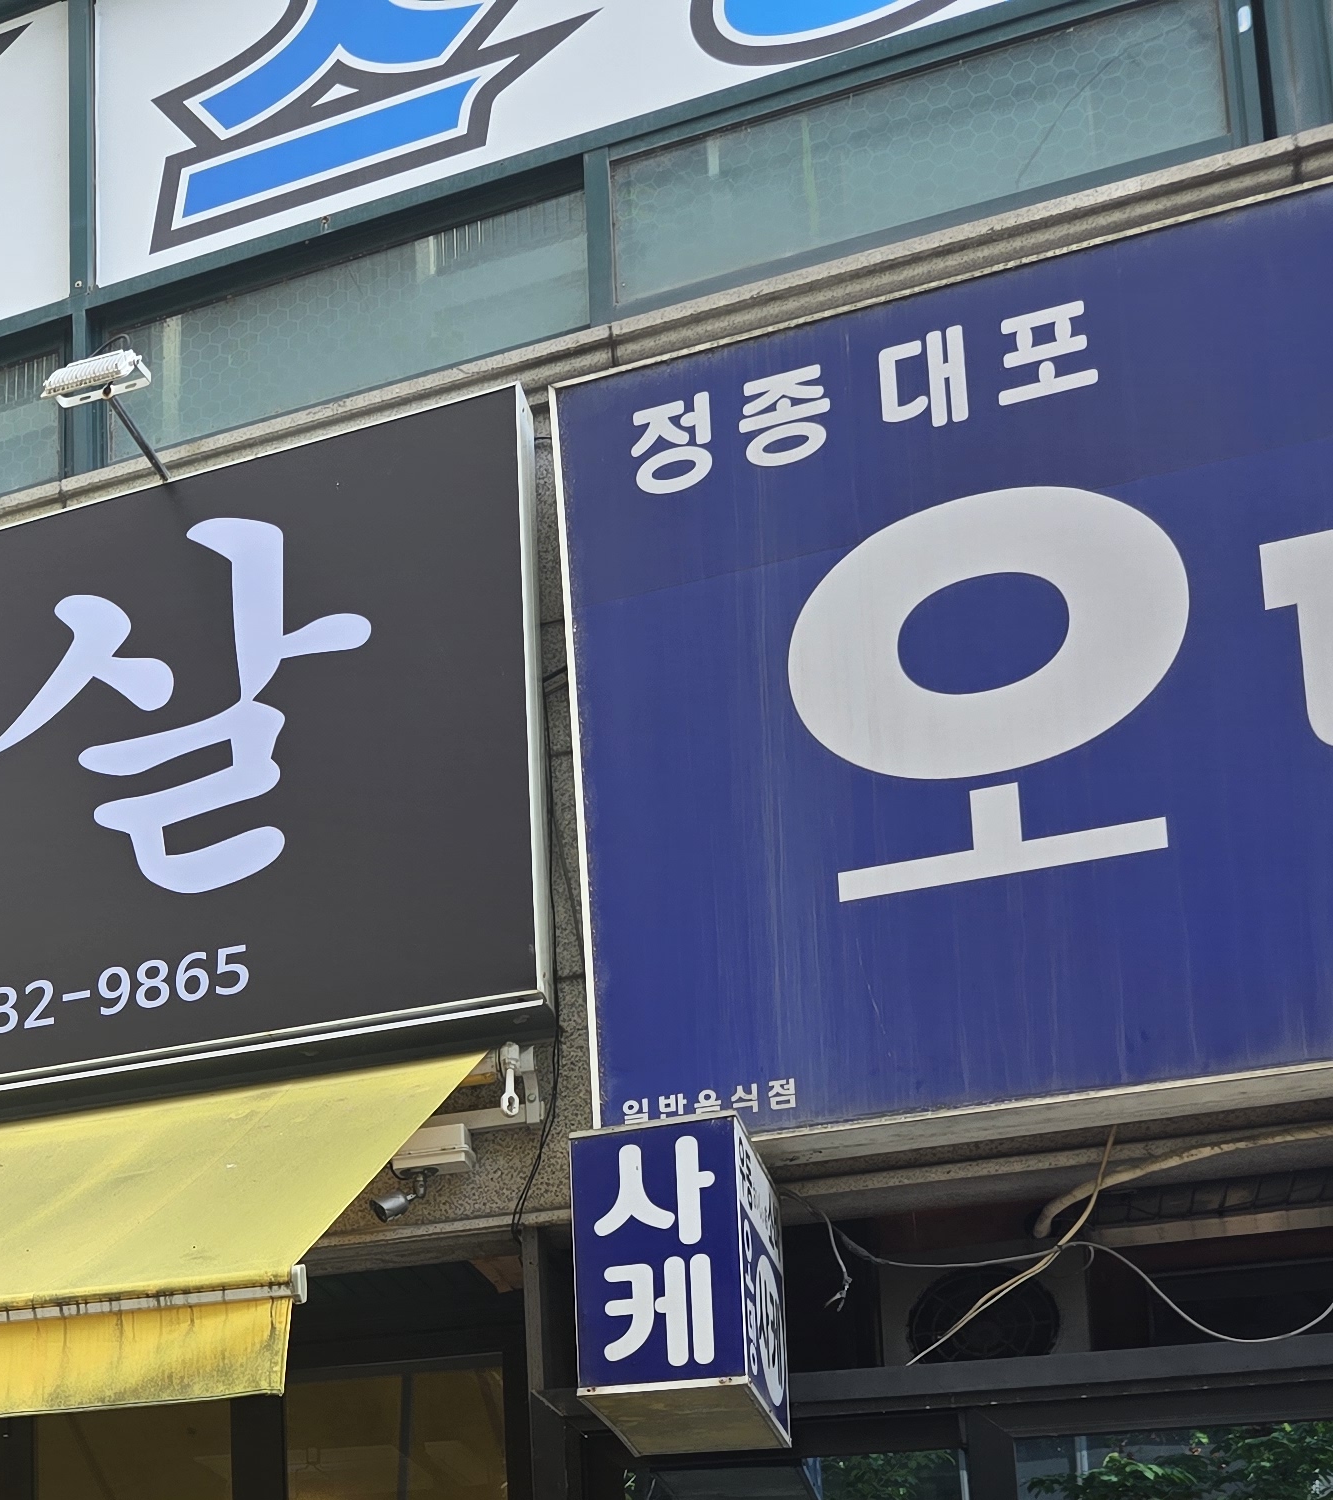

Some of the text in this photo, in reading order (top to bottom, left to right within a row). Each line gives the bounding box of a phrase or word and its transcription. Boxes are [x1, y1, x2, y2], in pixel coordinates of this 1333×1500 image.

[630, 300, 1099, 495] 정종 대포
[787, 485, 1333, 903] 오
[594, 1135, 716, 1368] 사케
